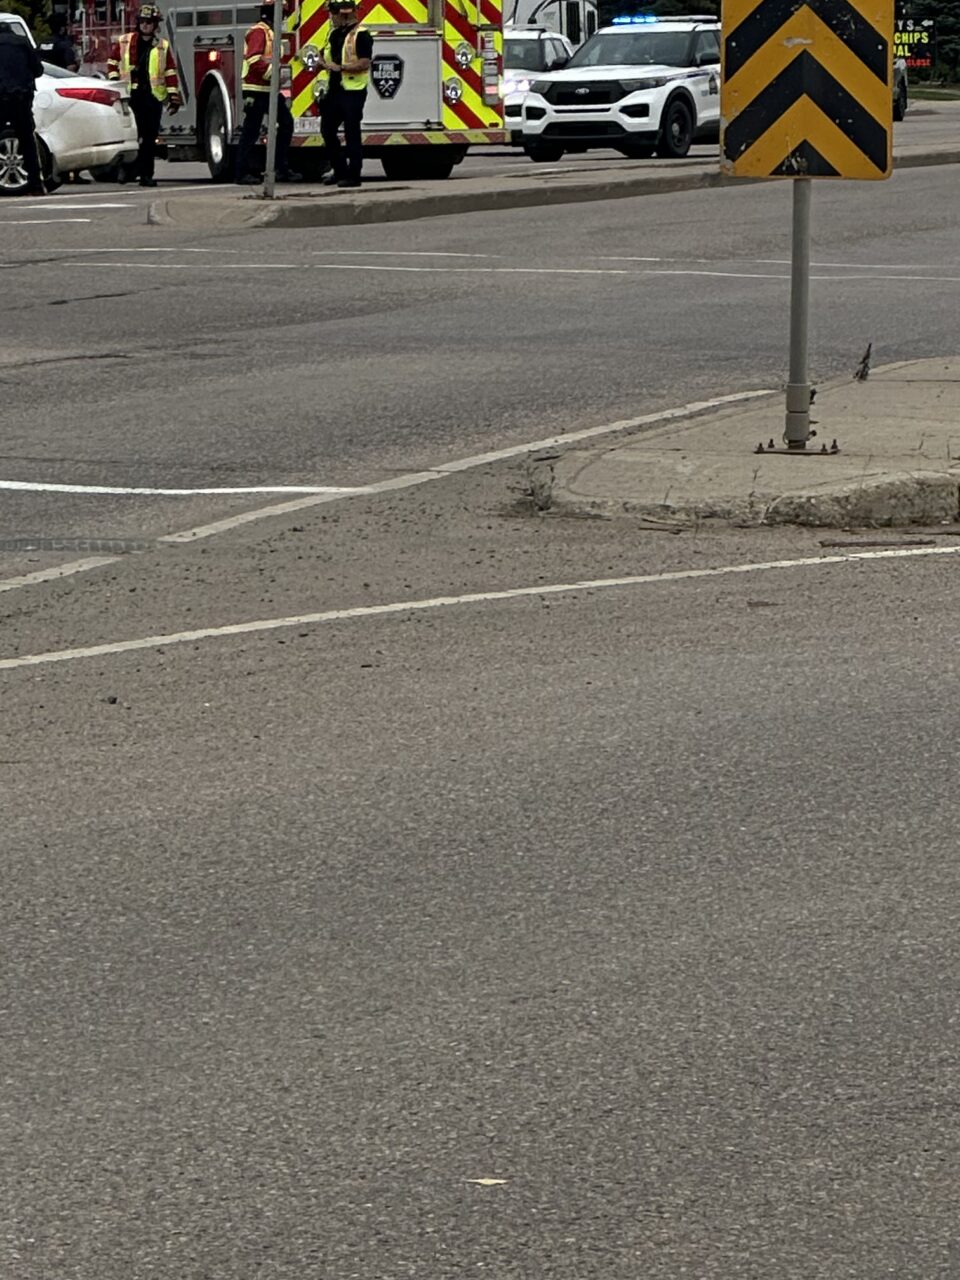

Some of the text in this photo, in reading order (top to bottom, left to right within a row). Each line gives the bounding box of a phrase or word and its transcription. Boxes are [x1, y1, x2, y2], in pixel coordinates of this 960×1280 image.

[894, 31, 929, 44] CHIPS
[379, 63, 395, 72] FIRE
[373, 70, 400, 79] RESCUE
